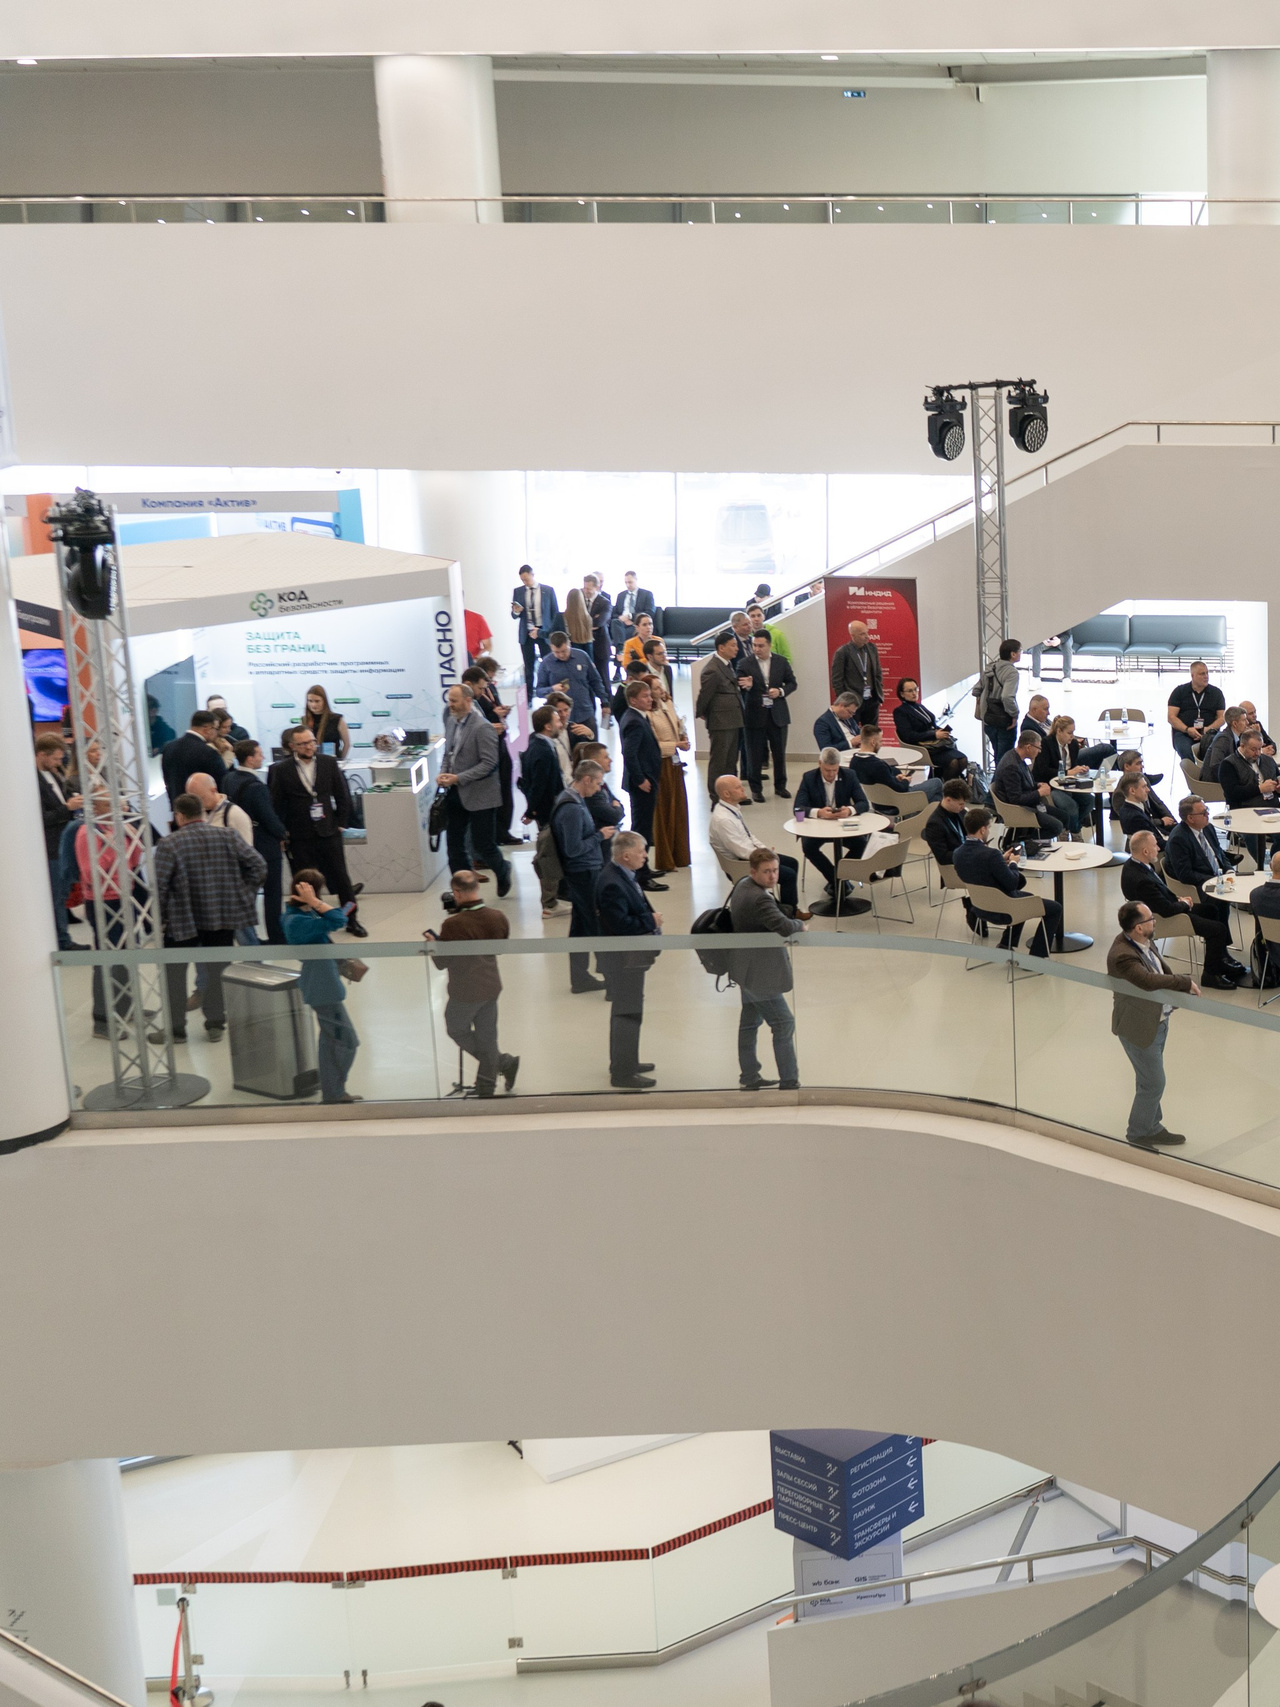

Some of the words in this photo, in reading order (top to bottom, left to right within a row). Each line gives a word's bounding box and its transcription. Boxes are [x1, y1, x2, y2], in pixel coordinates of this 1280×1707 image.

[141, 497, 204, 509] Компания
[208, 497, 258, 508] «Актив»
[277, 590, 308, 603] КОД
[246, 631, 301, 641] ЗАЩИТА
[246, 644, 273, 653] БЕЗ
[275, 644, 326, 654] ГРАНИЦ
[775, 1446, 806, 1464] ВЫСТАВКА
[850, 1446, 893, 1475] РЕГИСТРАЦИЯ
[794, 1476, 818, 1492] СЕССИЙ
[852, 1475, 887, 1498] ФОТОЗОНА
[853, 1503, 876, 1521] ЛАУНЖ
[778, 1511, 818, 1533] ПРЕСС-ЦЕНТР
[854, 1514, 891, 1540] ТРАНСФЕРЫ
[854, 1524, 890, 1550] ЭКСКУРСИИ
